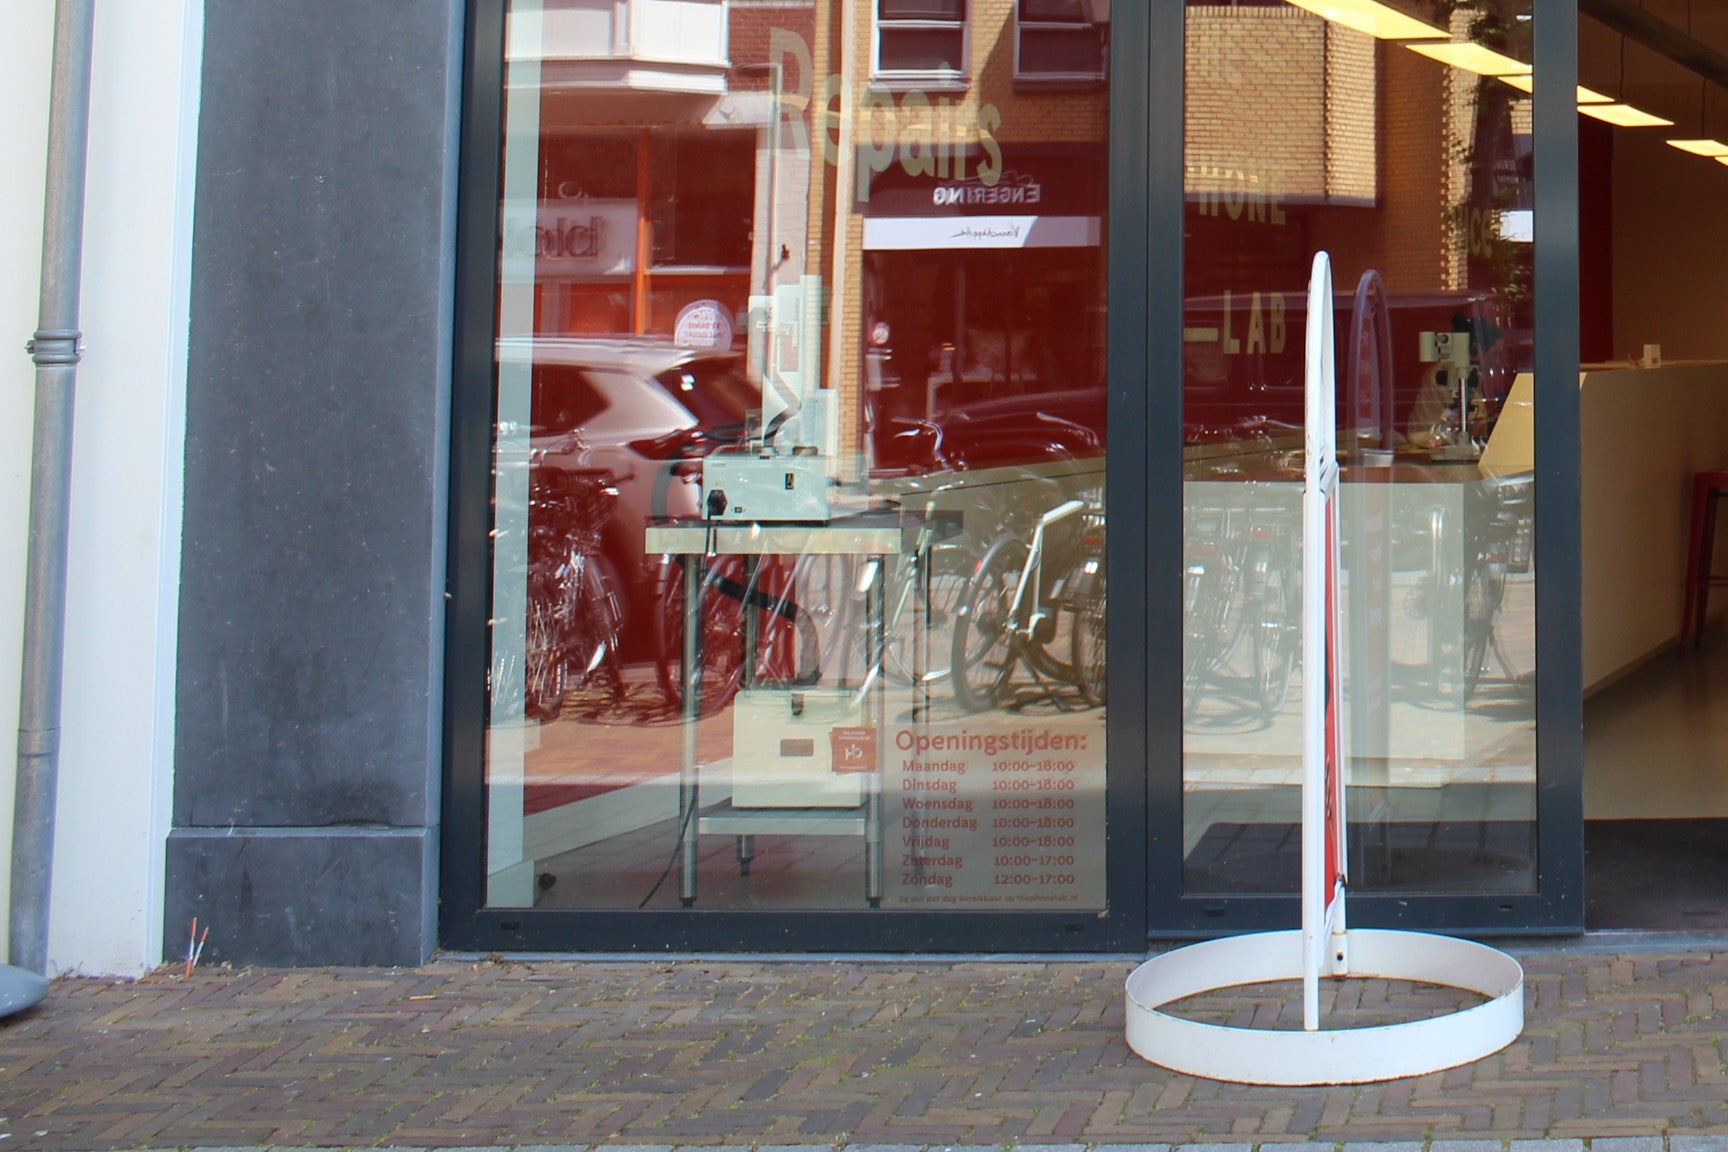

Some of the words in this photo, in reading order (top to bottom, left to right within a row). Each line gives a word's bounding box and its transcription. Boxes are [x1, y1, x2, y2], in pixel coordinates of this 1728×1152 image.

[769, 26, 1003, 202] Repairs
[1223, 289, 1286, 354] LAB
[895, 729, 1088, 756] Openingstijden:
[902, 760, 966, 774] Maandag
[902, 778, 957, 793] Dinsdag
[902, 797, 973, 812] Woensdag
[902, 816, 978, 831] Donderdag
[902, 835, 950, 850] Vrijdag
[902, 854, 963, 869] Zaterdag
[902, 873, 953, 888] Zondag
